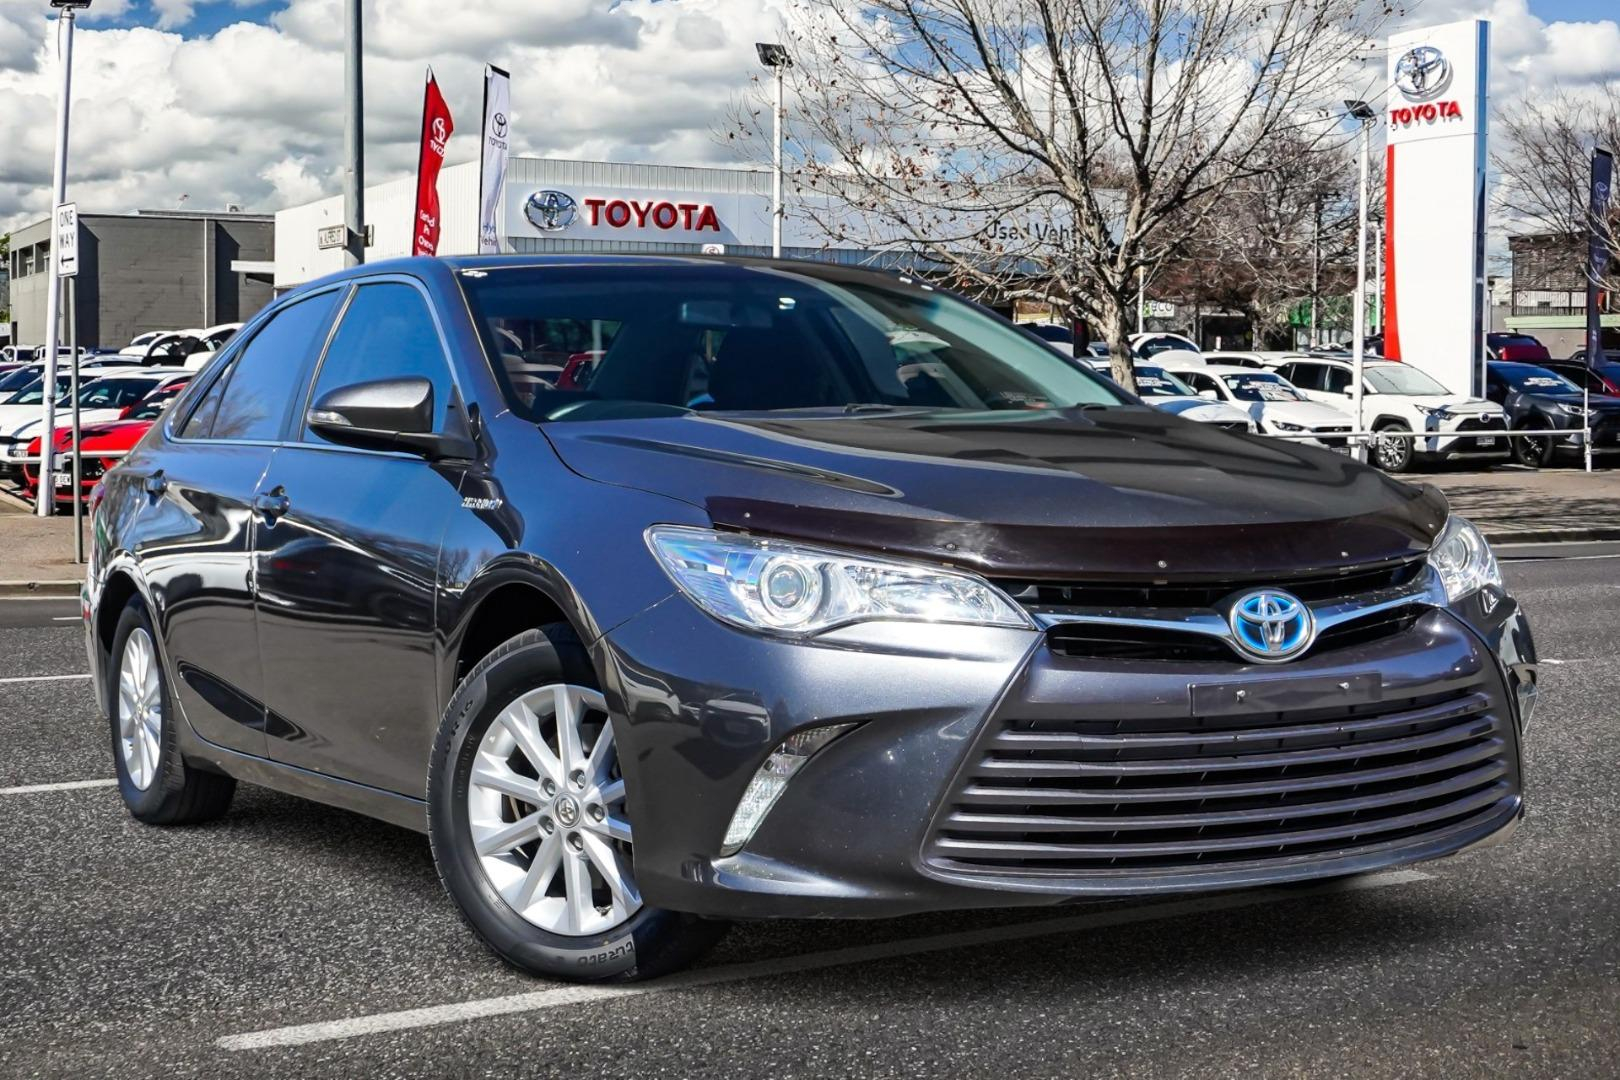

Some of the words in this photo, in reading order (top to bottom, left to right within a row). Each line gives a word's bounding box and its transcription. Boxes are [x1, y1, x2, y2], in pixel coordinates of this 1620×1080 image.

[1389, 101, 1462, 125] TOYOTA
[59, 210, 74, 228] ONE
[584, 198, 721, 232] TOYOTA
[59, 232, 75, 249] WAY
